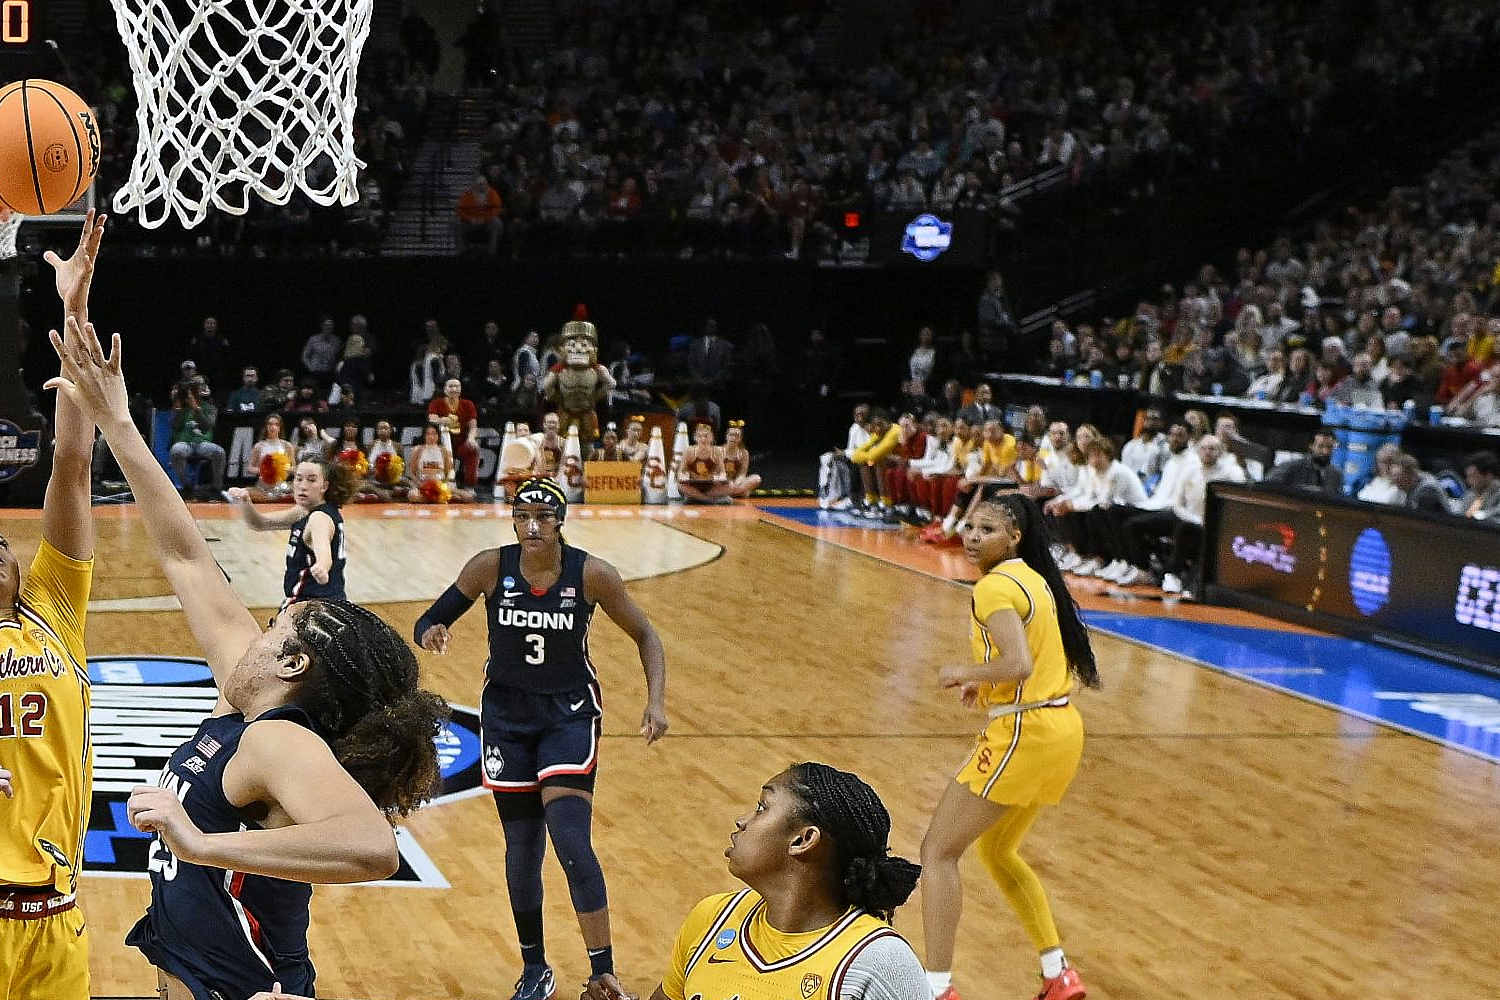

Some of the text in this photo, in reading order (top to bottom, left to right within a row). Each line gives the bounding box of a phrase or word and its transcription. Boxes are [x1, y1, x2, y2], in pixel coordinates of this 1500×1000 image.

[498, 607, 574, 631] UCONN
[525, 633, 545, 666] 3
[21, 901, 43, 913] USC
